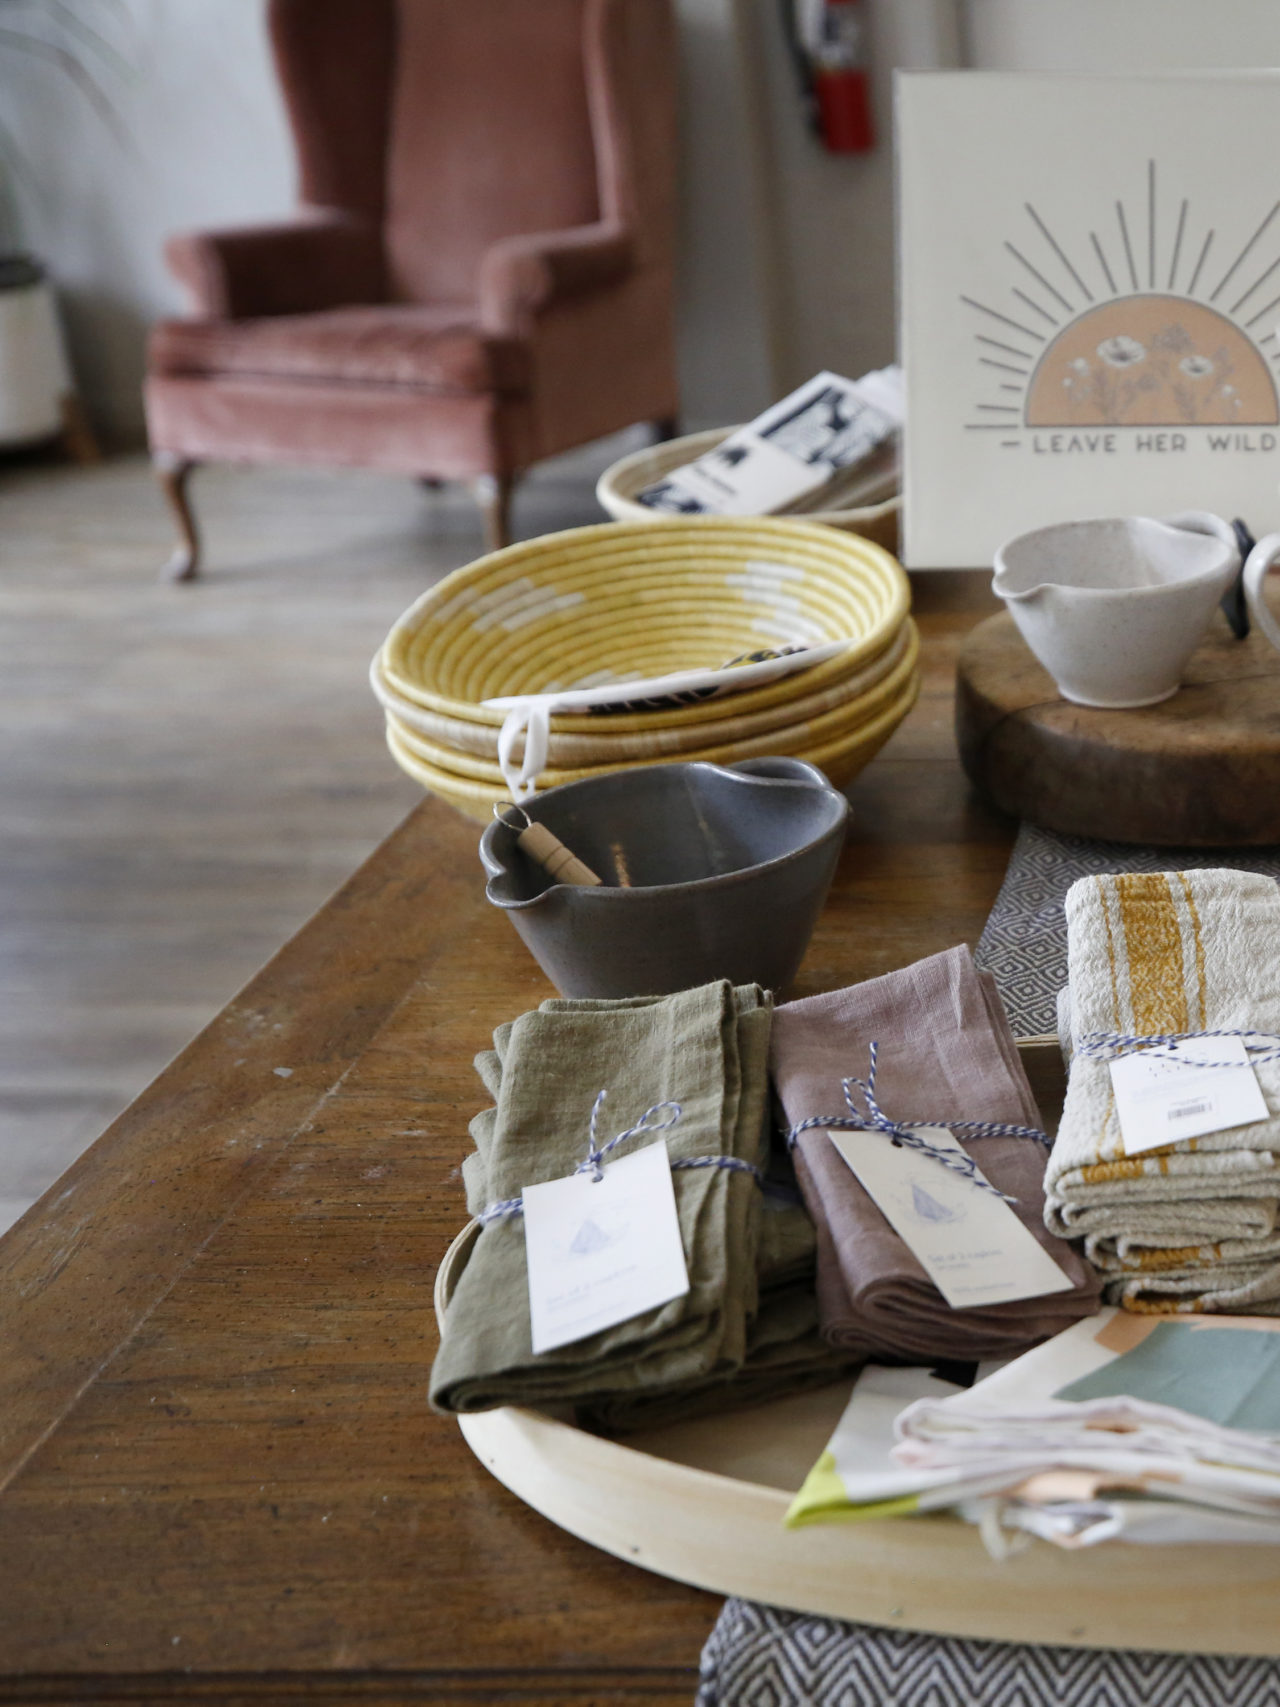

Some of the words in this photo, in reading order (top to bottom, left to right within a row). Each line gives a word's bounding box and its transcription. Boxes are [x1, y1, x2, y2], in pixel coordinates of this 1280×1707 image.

[1033, 434, 1117, 453] LEAVE
[1136, 433, 1187, 452] HER
[1207, 433, 1277, 452] WILD
